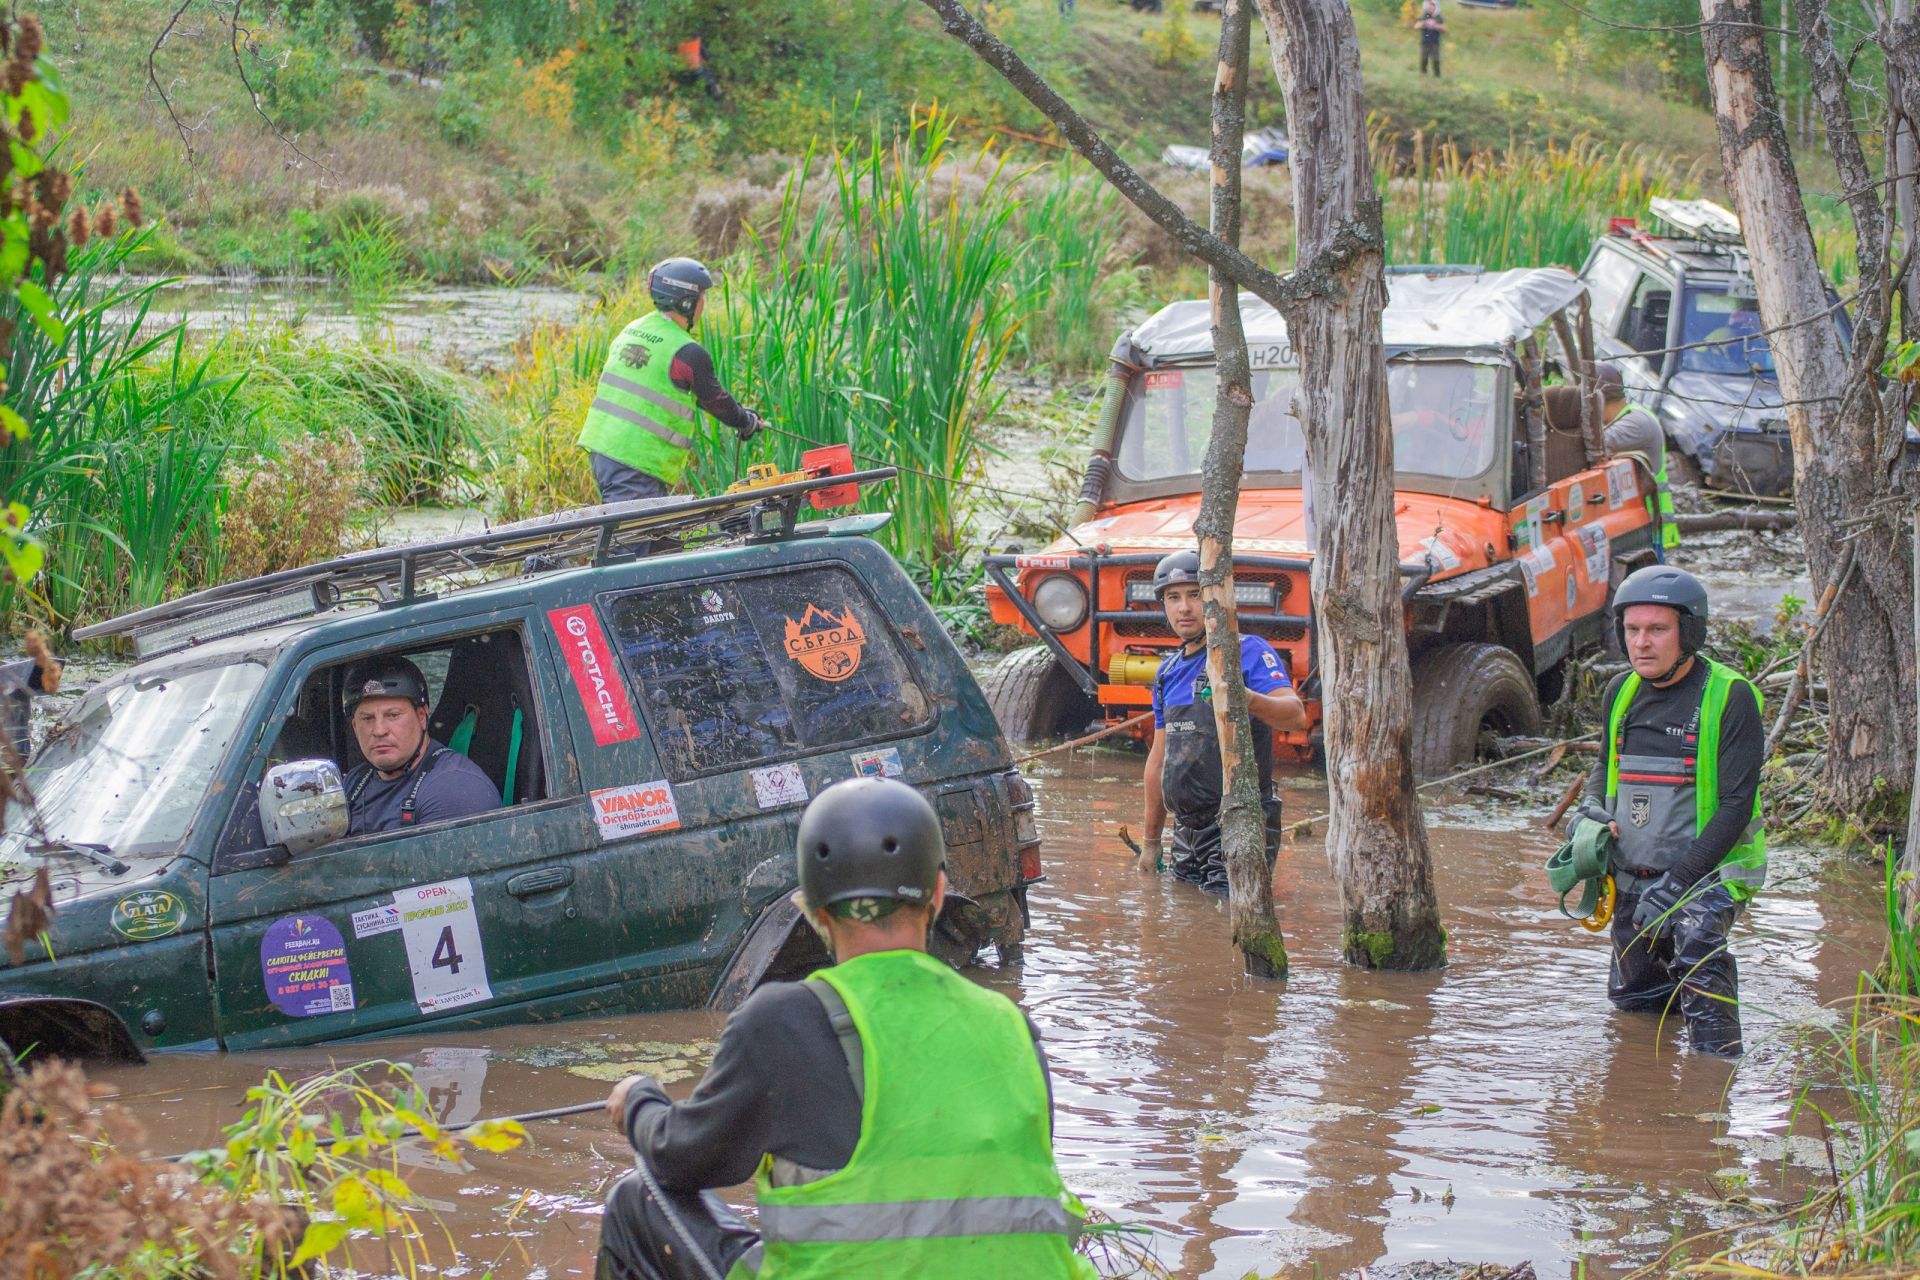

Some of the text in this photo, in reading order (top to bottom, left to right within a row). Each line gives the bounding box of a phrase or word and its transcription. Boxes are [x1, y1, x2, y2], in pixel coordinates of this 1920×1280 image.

[703, 612, 735, 625] DAKOTA
[577, 636, 619, 725] TOTACHI
[597, 789, 671, 813] VIANOR
[602, 806, 673, 825] Октябрьский
[620, 818, 660, 831] shinaokt.ru
[417, 886, 448, 900] OPEN
[128, 903, 167, 919] ZLATA
[354, 912, 379, 924] ТАКТИКА
[356, 919, 385, 931] СУСАНИНА
[431, 924, 464, 975] 4
[288, 967, 329, 982] СКИДКИ!
